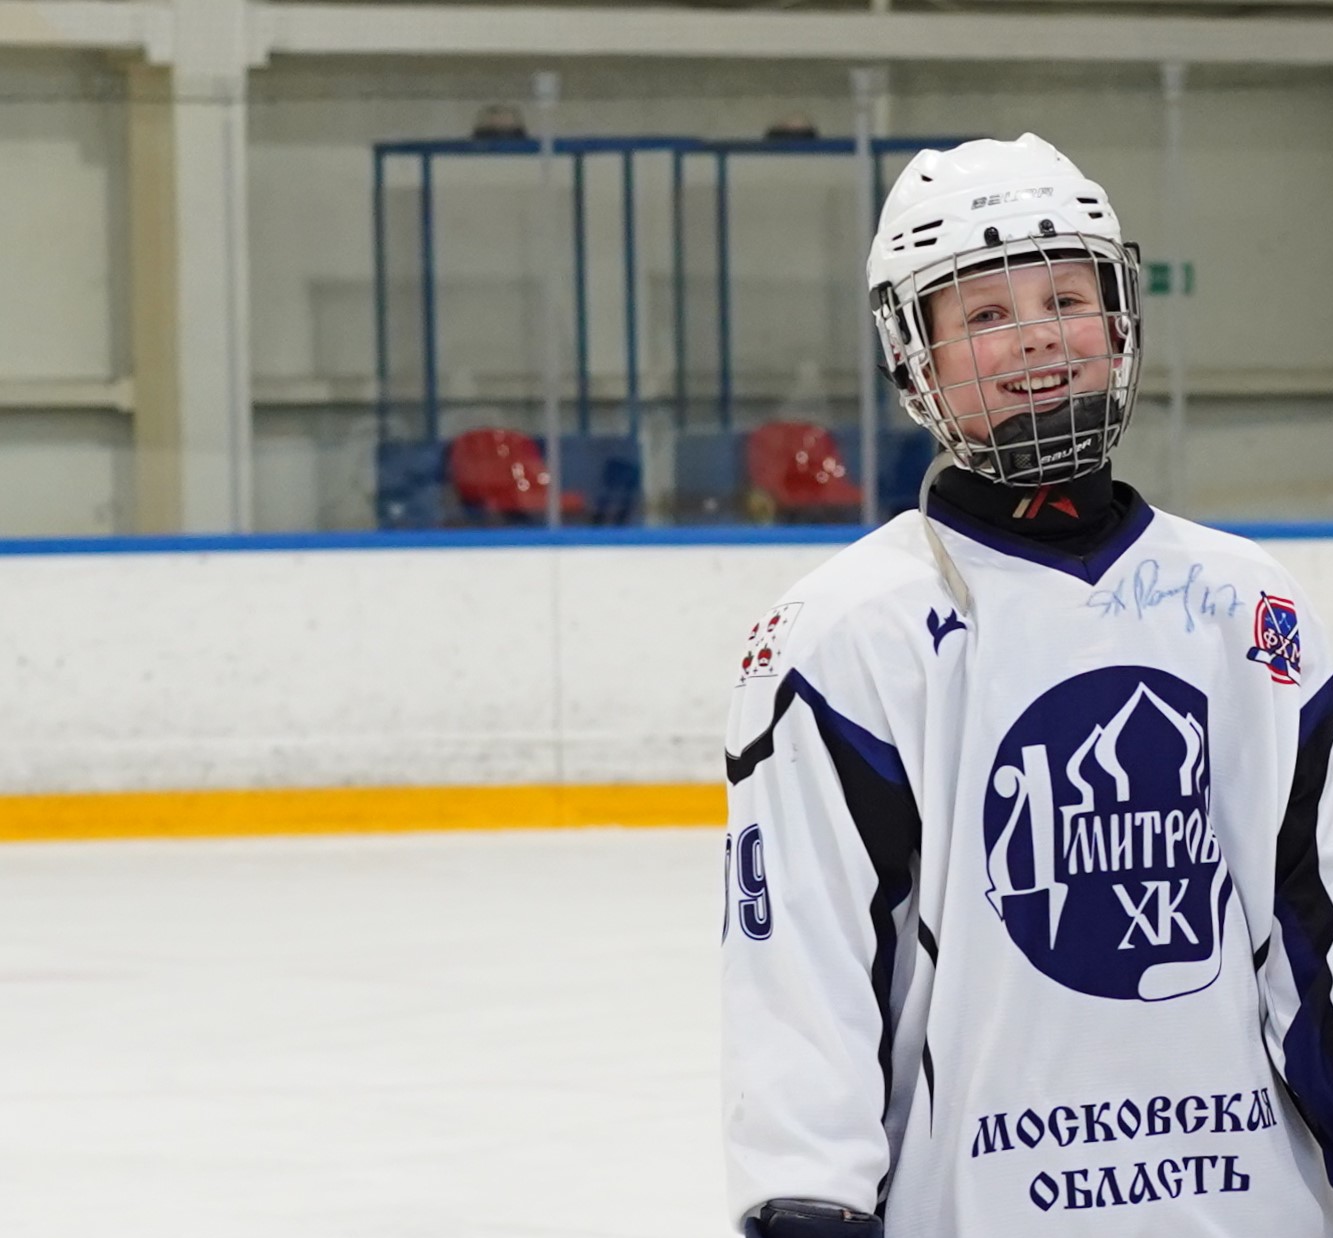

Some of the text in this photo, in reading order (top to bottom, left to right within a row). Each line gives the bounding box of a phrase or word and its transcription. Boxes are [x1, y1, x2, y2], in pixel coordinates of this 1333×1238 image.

[721, 823, 774, 942] 9
[1112, 878, 1200, 950] ХК
[971, 1087, 1277, 1158] МОСКОВСКАЯ
[1029, 1155, 1251, 1212] ОБЛАСТЬ
